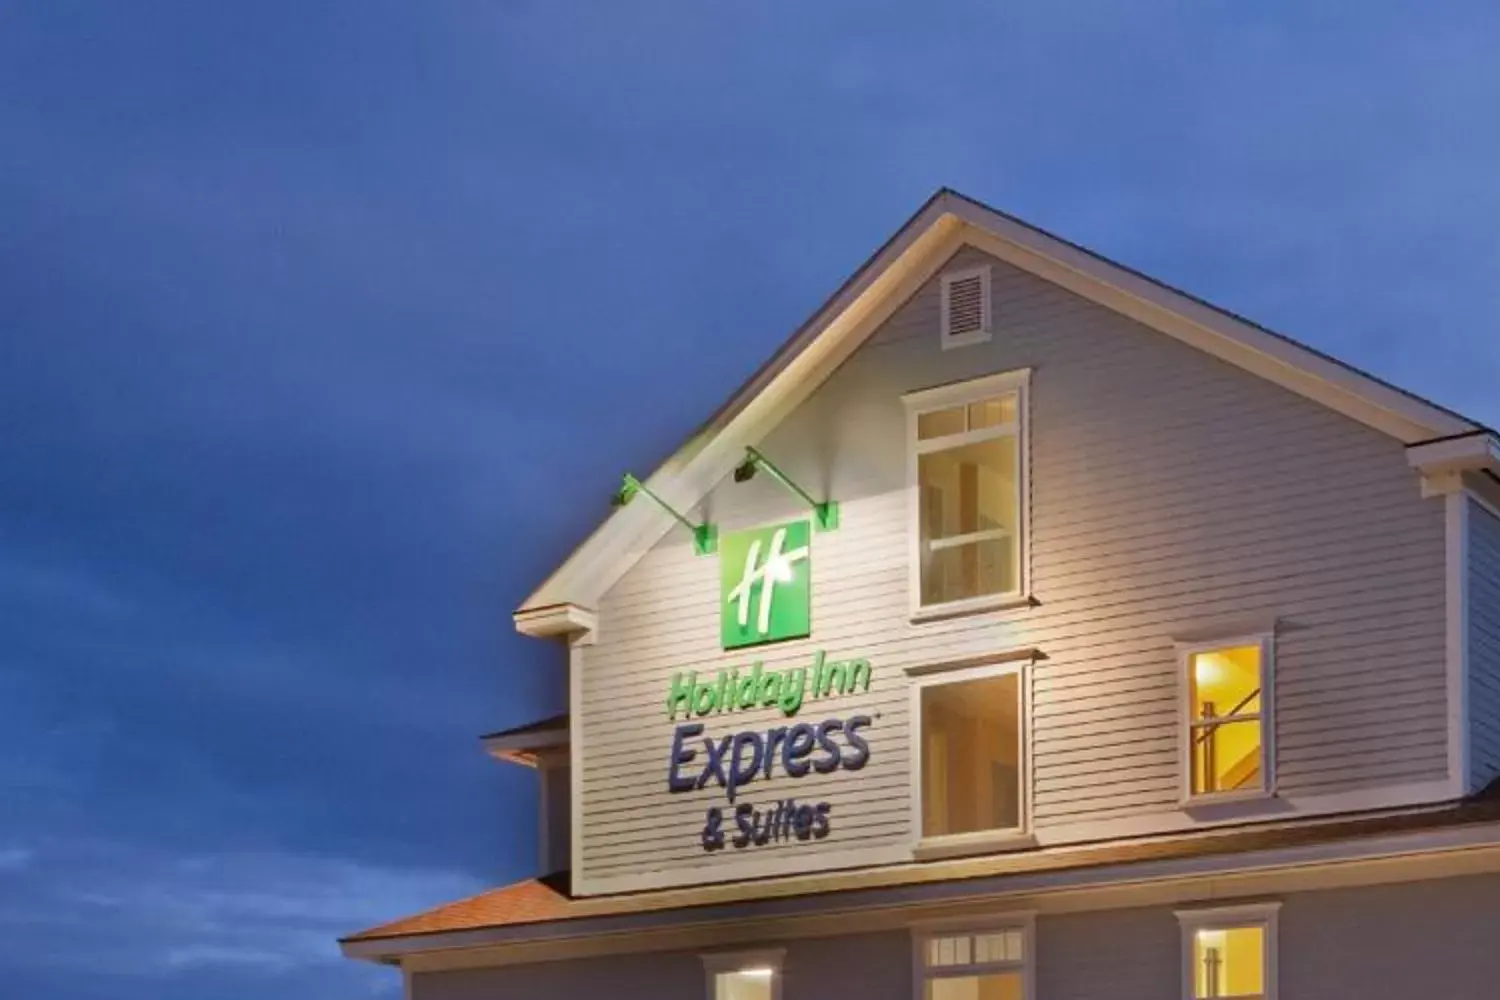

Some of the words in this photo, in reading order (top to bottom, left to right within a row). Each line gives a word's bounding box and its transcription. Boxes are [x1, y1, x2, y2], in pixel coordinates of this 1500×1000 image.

[727, 527, 809, 635] H
[667, 661, 806, 718] Holiday
[811, 649, 872, 698] Inn
[669, 714, 872, 803] Express
[702, 807, 724, 850] &
[732, 800, 832, 848] Suites
